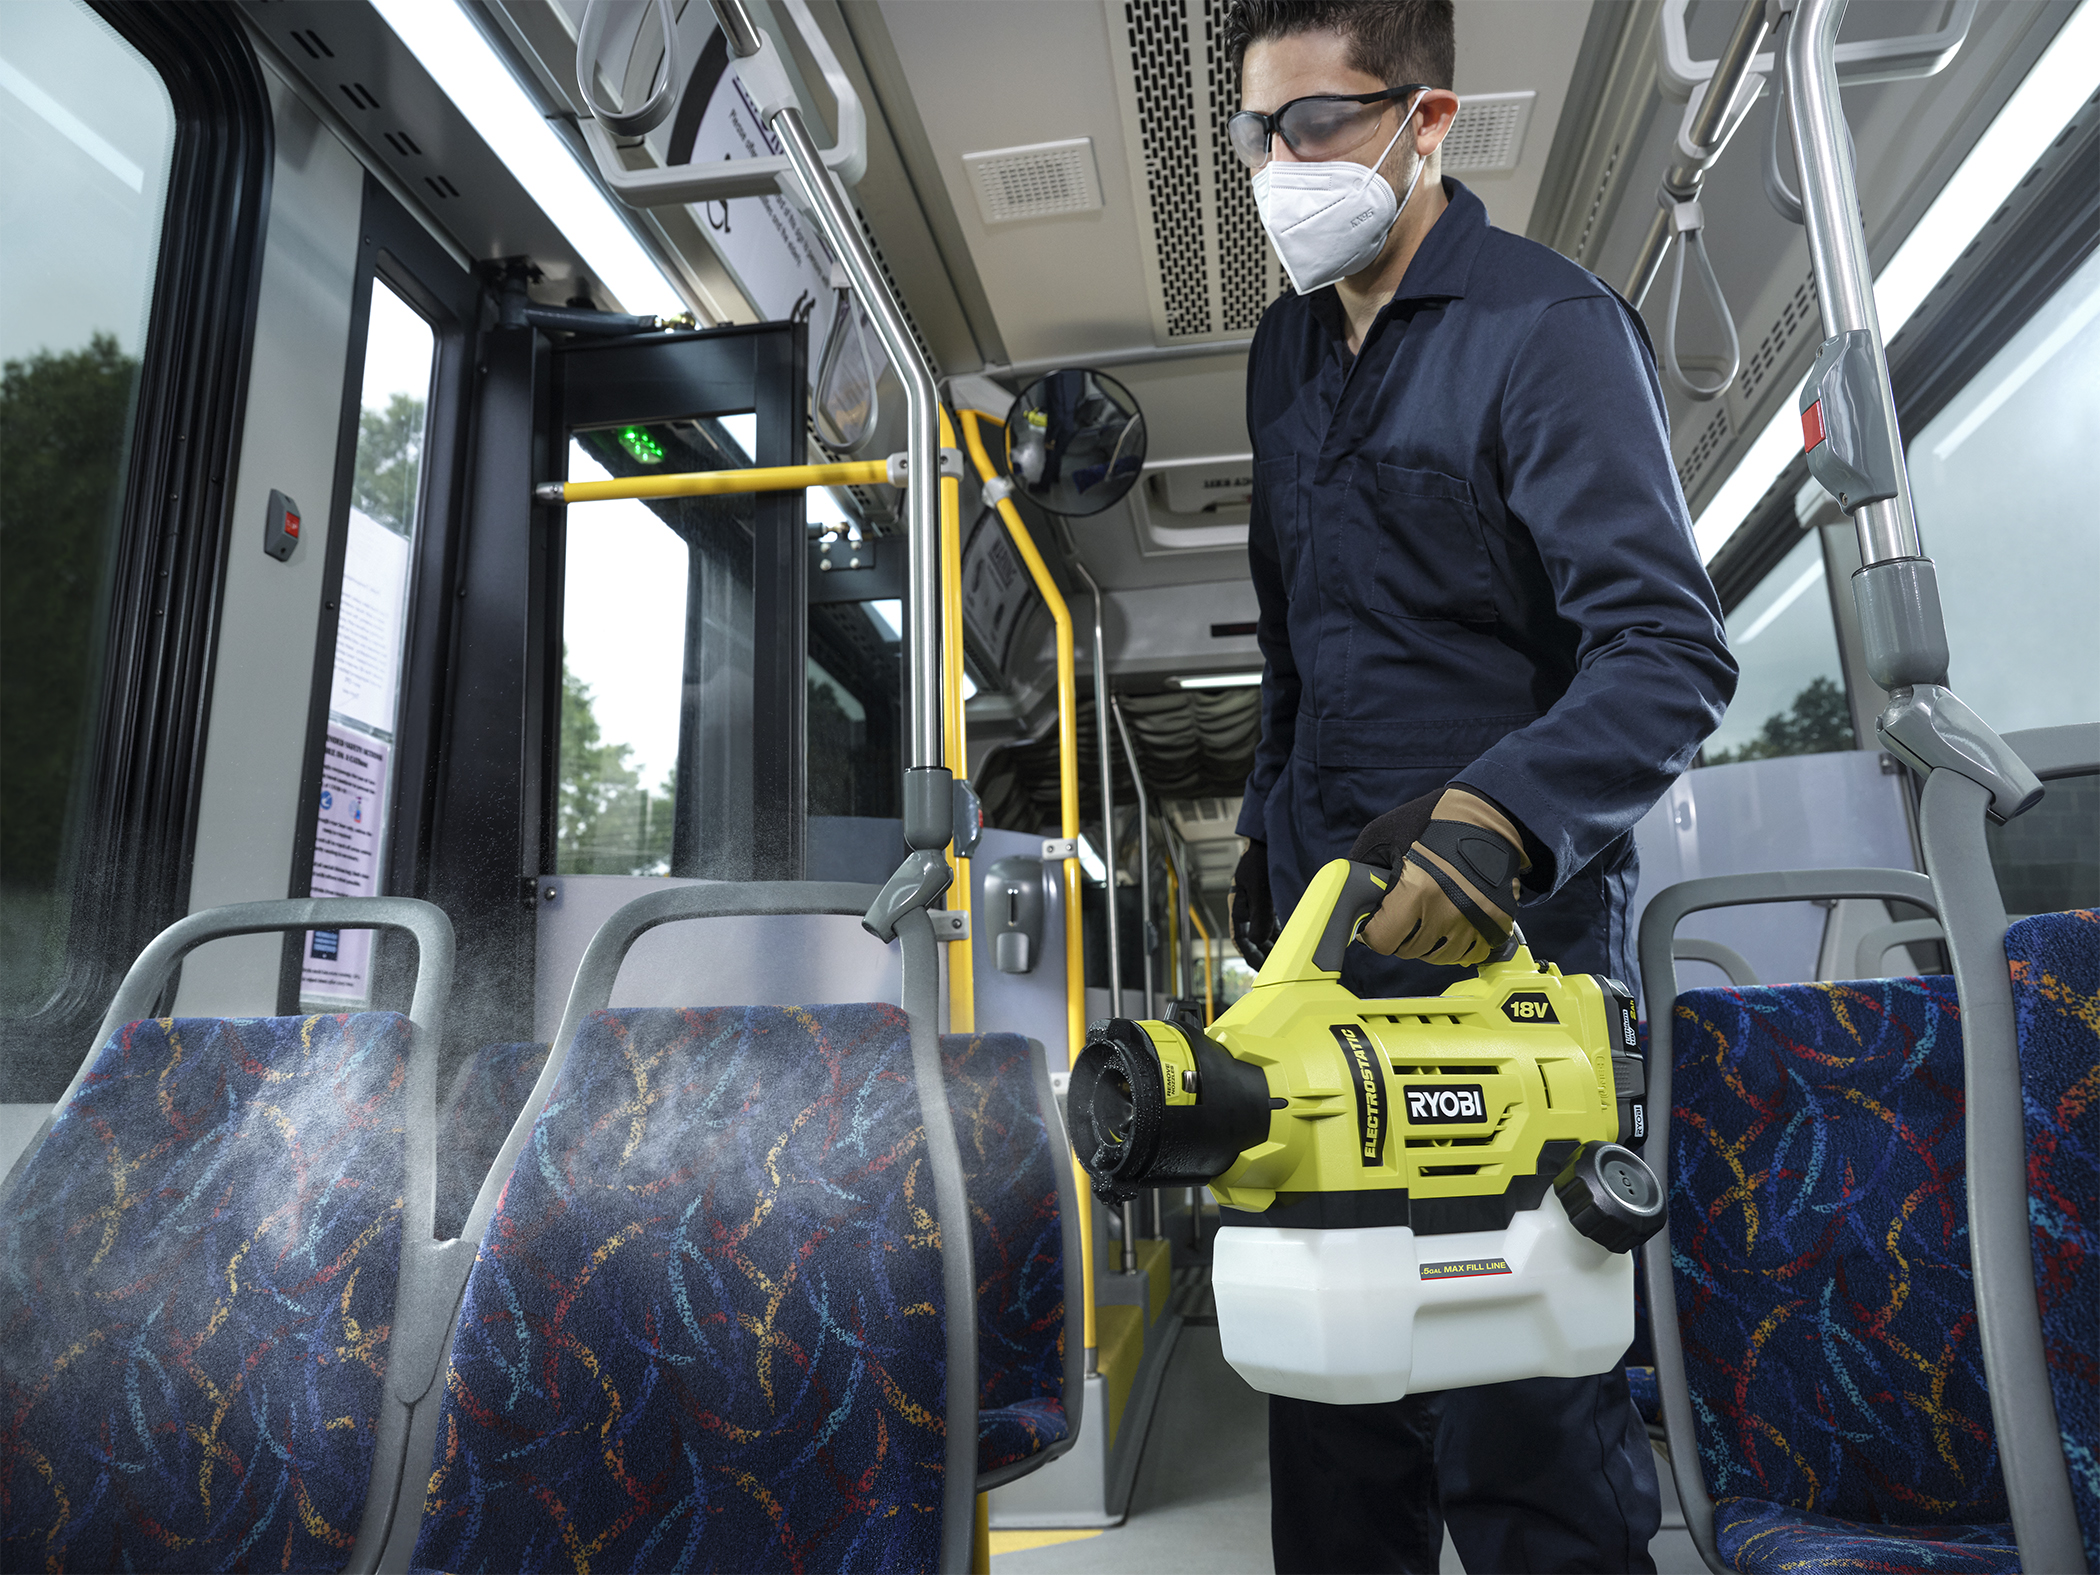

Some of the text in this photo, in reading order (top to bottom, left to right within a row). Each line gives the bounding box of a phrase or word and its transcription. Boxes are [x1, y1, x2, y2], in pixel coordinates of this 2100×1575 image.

[1350, 208, 1374, 228] KN95
[1510, 1001, 1549, 1018] 18V
[1341, 1028, 1379, 1158] ELECTROSTATIC
[1407, 1091, 1482, 1117] RYOBI
[1635, 1106, 1643, 1136] RYOBI
[1443, 1264, 1465, 1273] MAX
[1466, 1264, 1484, 1272] FILL
[1486, 1261, 1507, 1270] LINE
